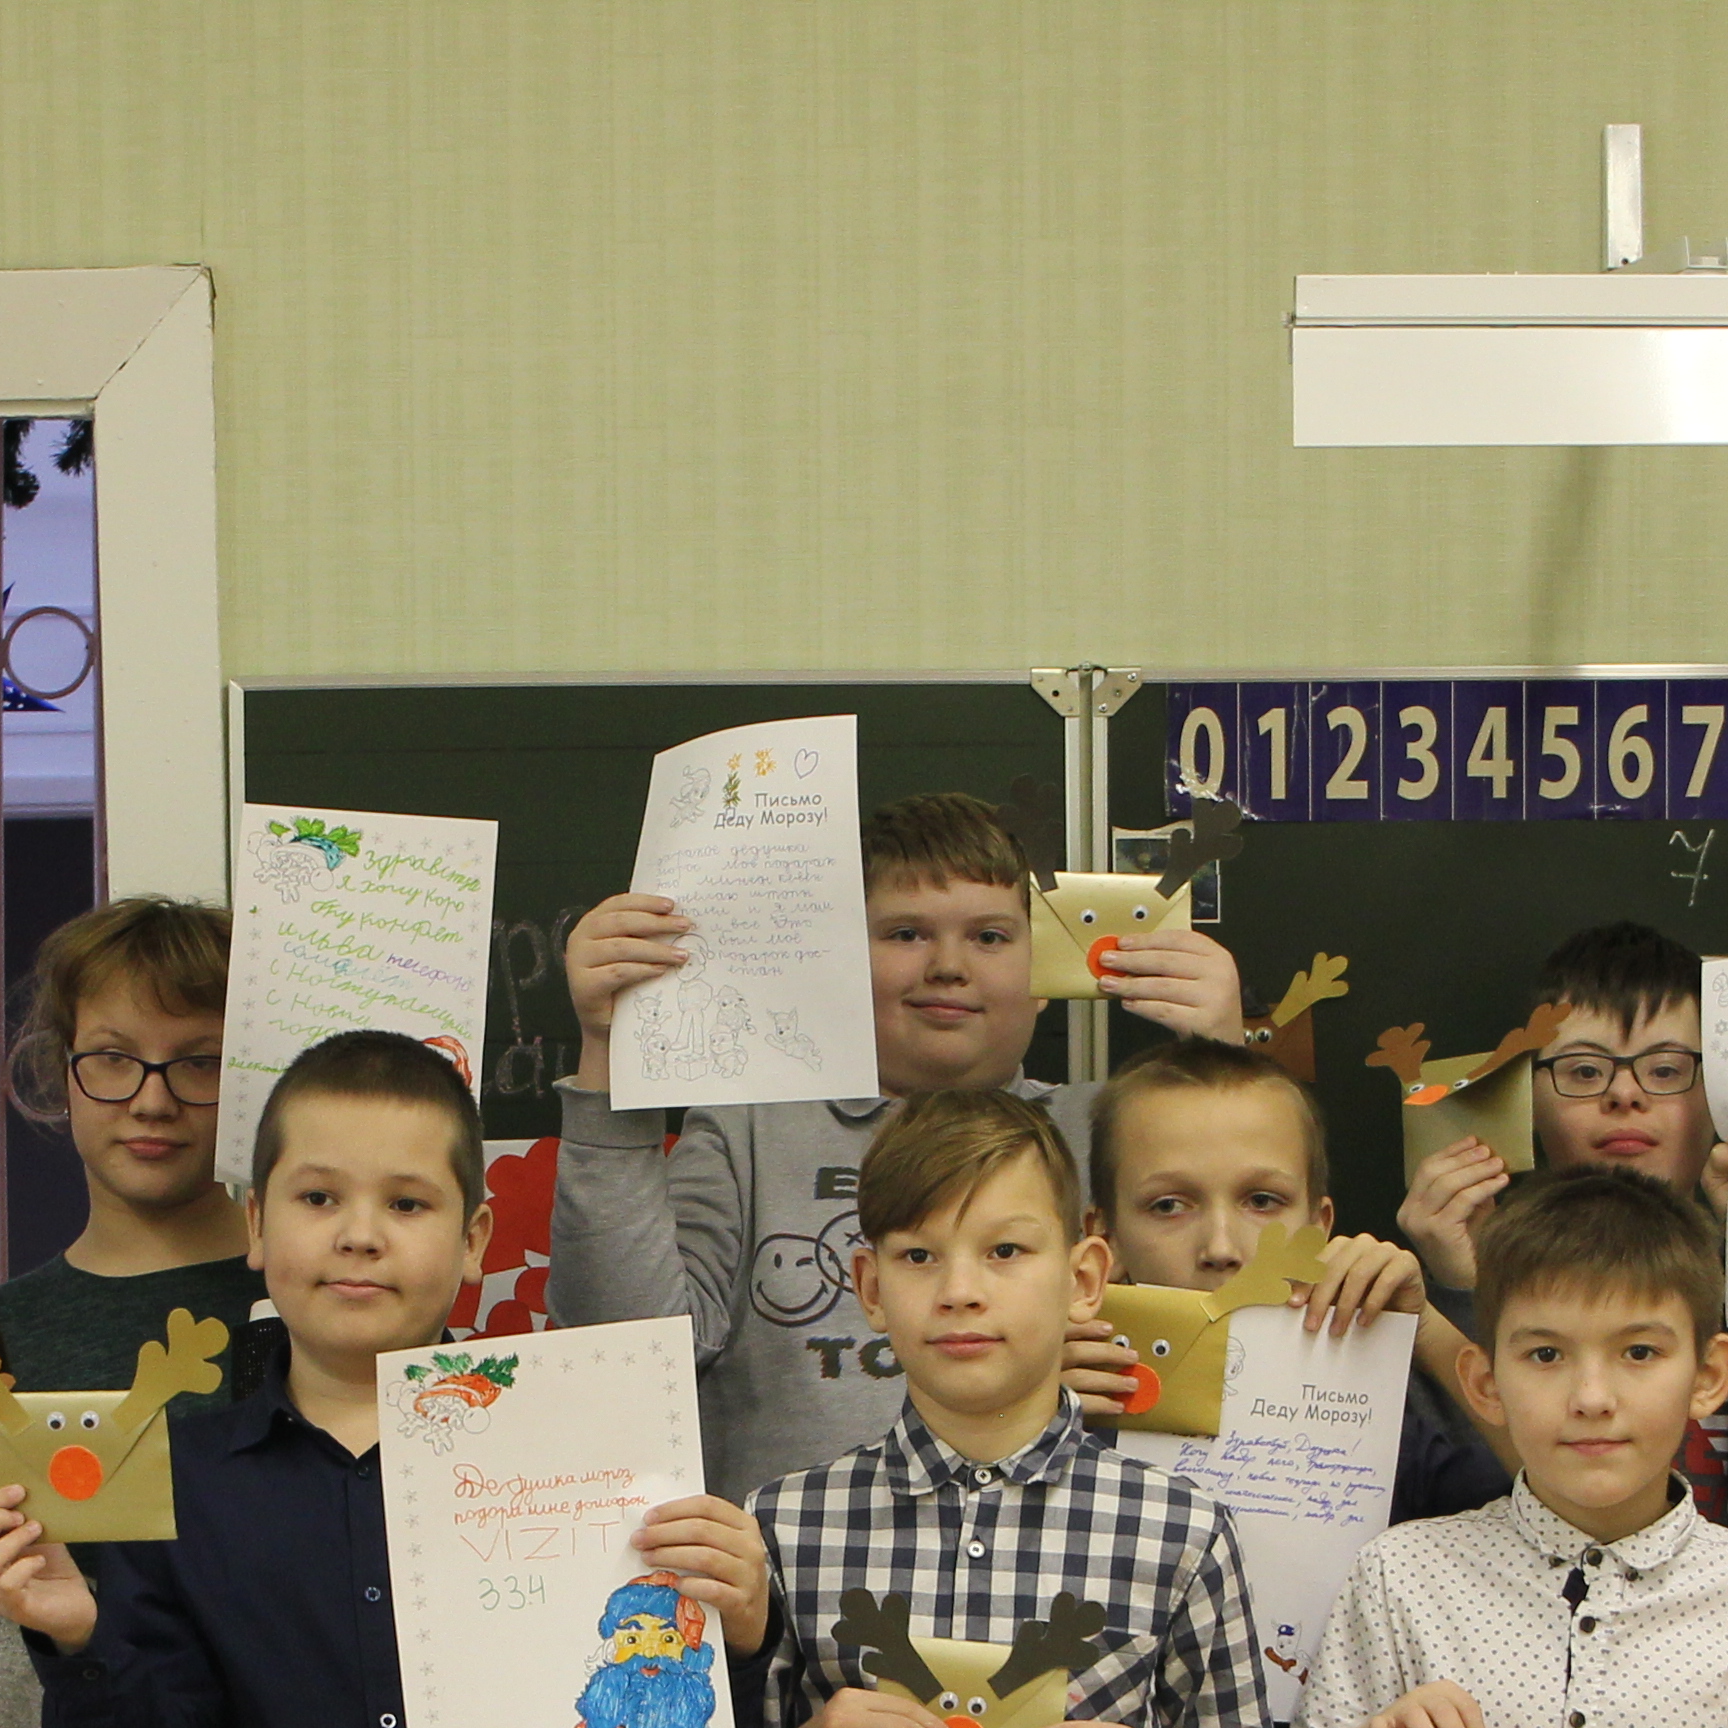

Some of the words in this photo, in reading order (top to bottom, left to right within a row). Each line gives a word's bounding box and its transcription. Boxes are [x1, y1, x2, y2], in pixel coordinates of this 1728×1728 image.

[1179, 707, 1225, 798] 0
[1258, 707, 1286, 799] 1
[1326, 706, 1368, 799] 2
[1398, 705, 1439, 800] 3
[1467, 707, 1514, 798] 4
[1539, 706, 1581, 800] 5
[1608, 704, 1654, 799] 6
[1682, 705, 1725, 798] 7
[754, 792, 823, 808] Письмо
[713, 812, 755, 830] Деду
[760, 807, 829, 829] Морозу!
[1669, 828, 1716, 907] 7
[1301, 1383, 1369, 1406] Письмо
[1250, 1398, 1300, 1423] Деду
[1304, 1403, 1373, 1429] Морозу!
[459, 1520, 621, 1563] VIZIT
